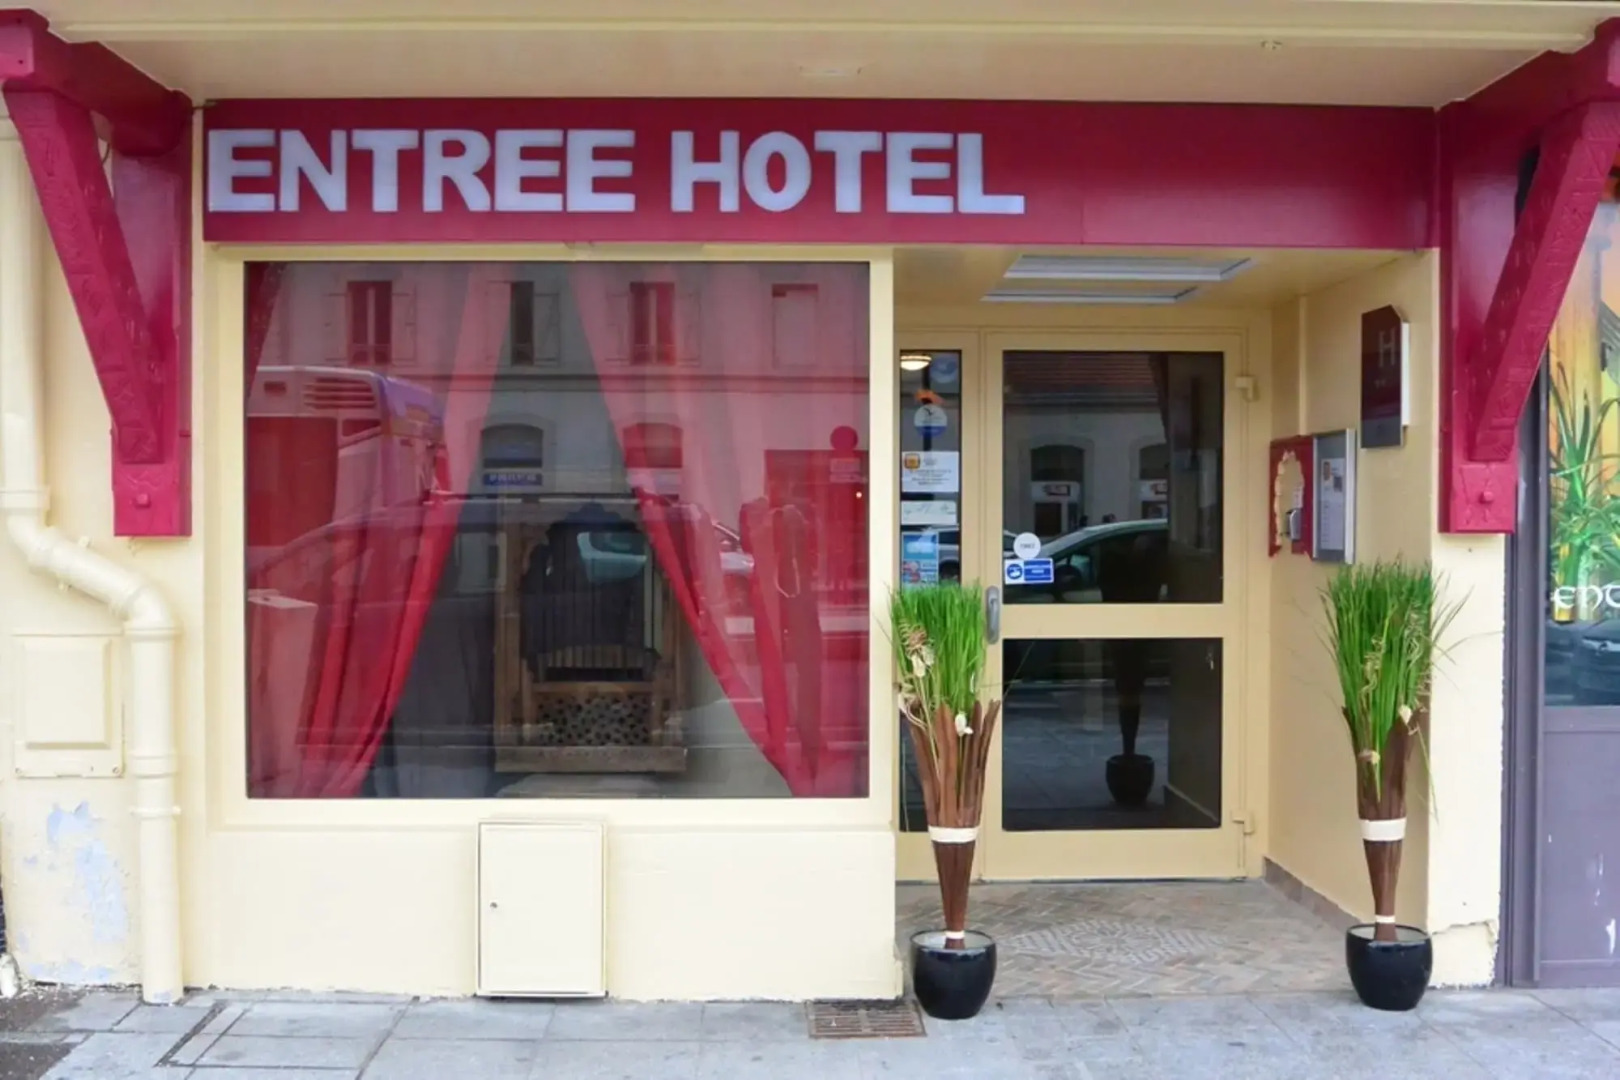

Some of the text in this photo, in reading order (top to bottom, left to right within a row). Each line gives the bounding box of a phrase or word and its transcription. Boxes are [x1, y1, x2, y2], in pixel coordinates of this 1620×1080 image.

[208, 128, 1026, 216] ENTREE HOTEL
[1379, 327, 1396, 367] H
